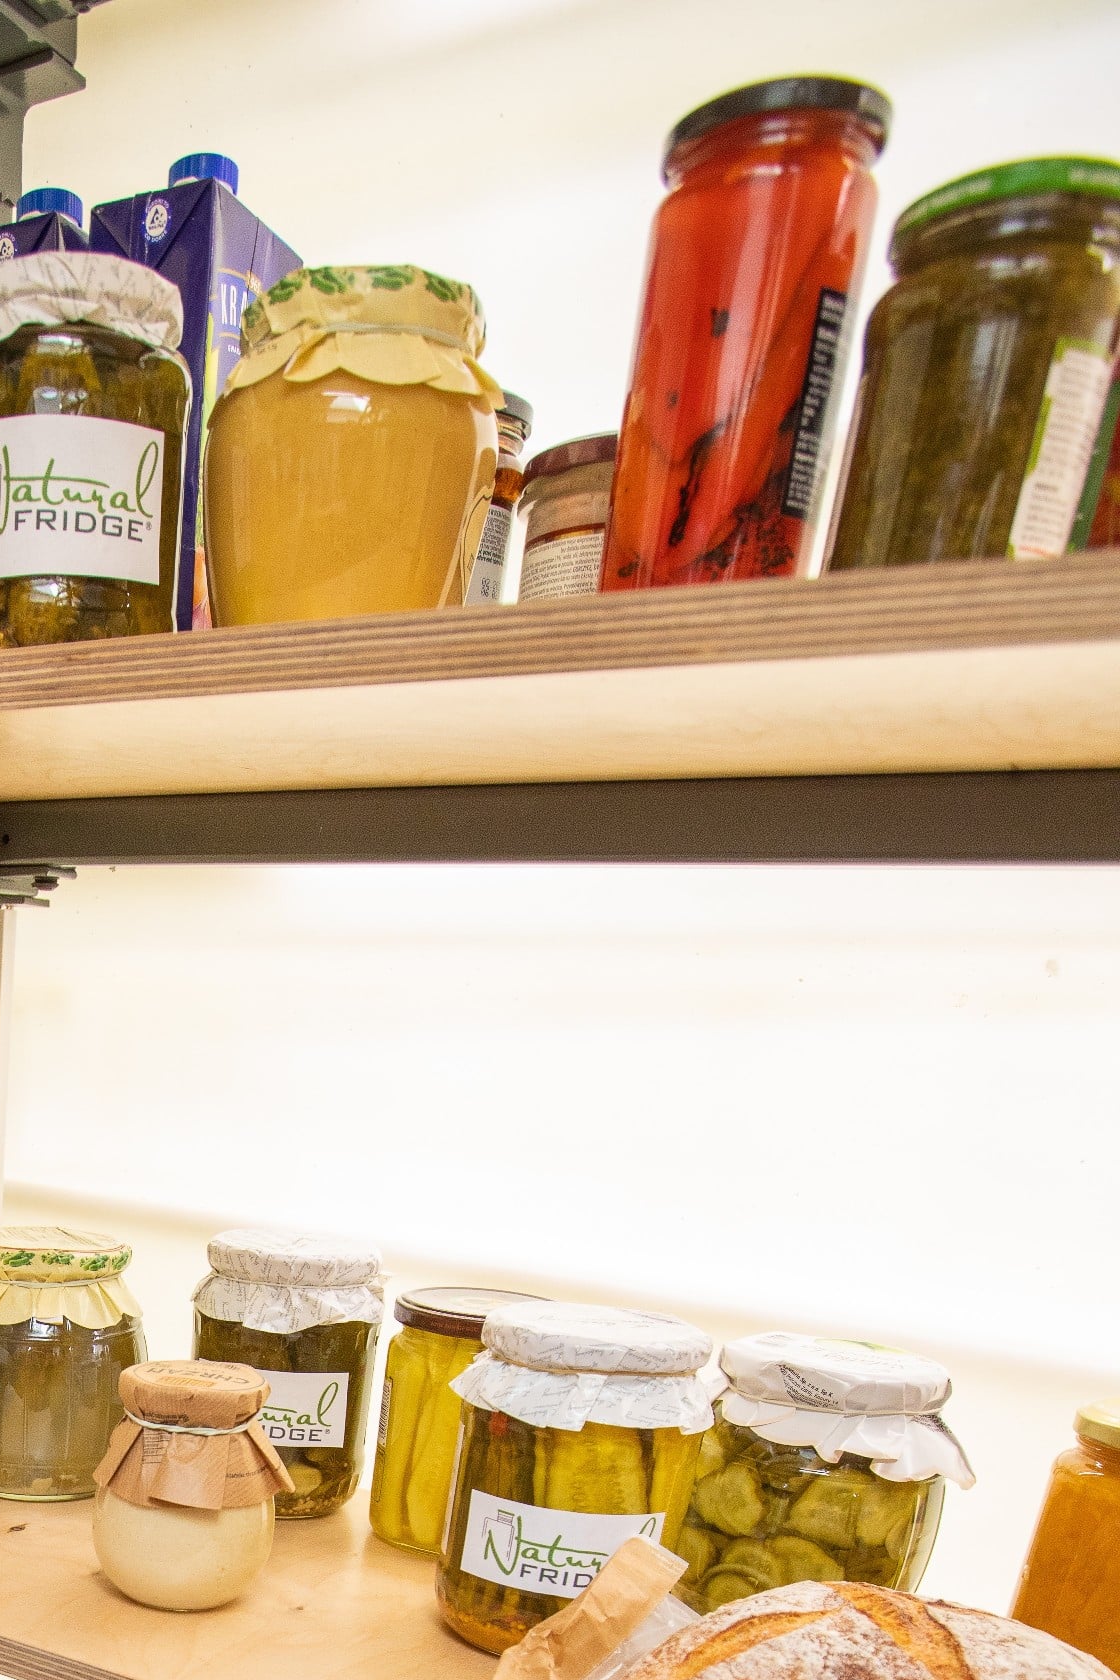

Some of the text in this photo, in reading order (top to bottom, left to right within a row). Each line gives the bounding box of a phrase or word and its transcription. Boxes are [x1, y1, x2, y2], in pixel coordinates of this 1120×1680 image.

[257, 1382, 339, 1427] ural
[262, 1425, 322, 1441] DGE
[484, 1516, 656, 1576] Natur
[519, 1563, 594, 1588] FRID
